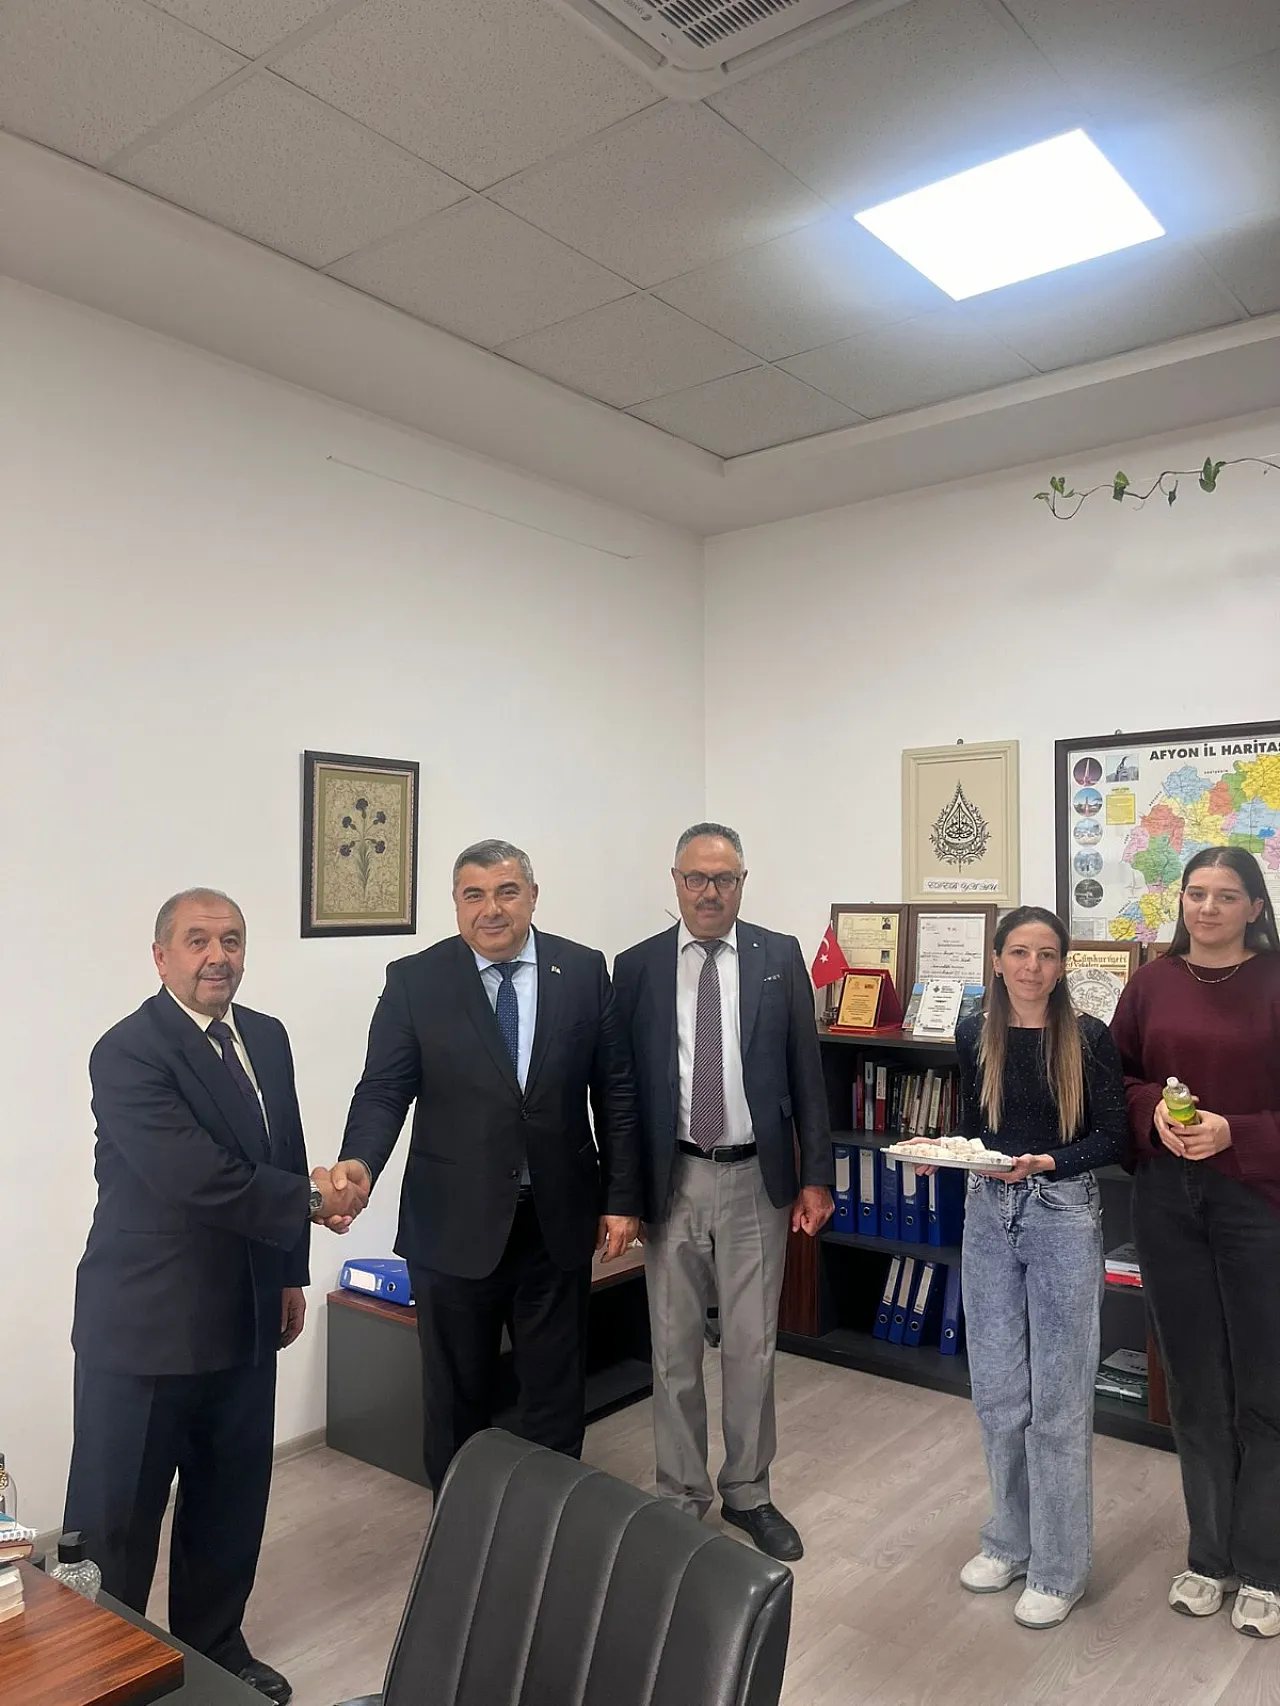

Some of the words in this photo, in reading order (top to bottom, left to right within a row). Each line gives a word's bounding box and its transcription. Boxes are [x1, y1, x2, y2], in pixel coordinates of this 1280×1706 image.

[1149, 747, 1199, 760] AFYON
[1203, 743, 1216, 757] İL
[1221, 739, 1280, 756] HARİTA
